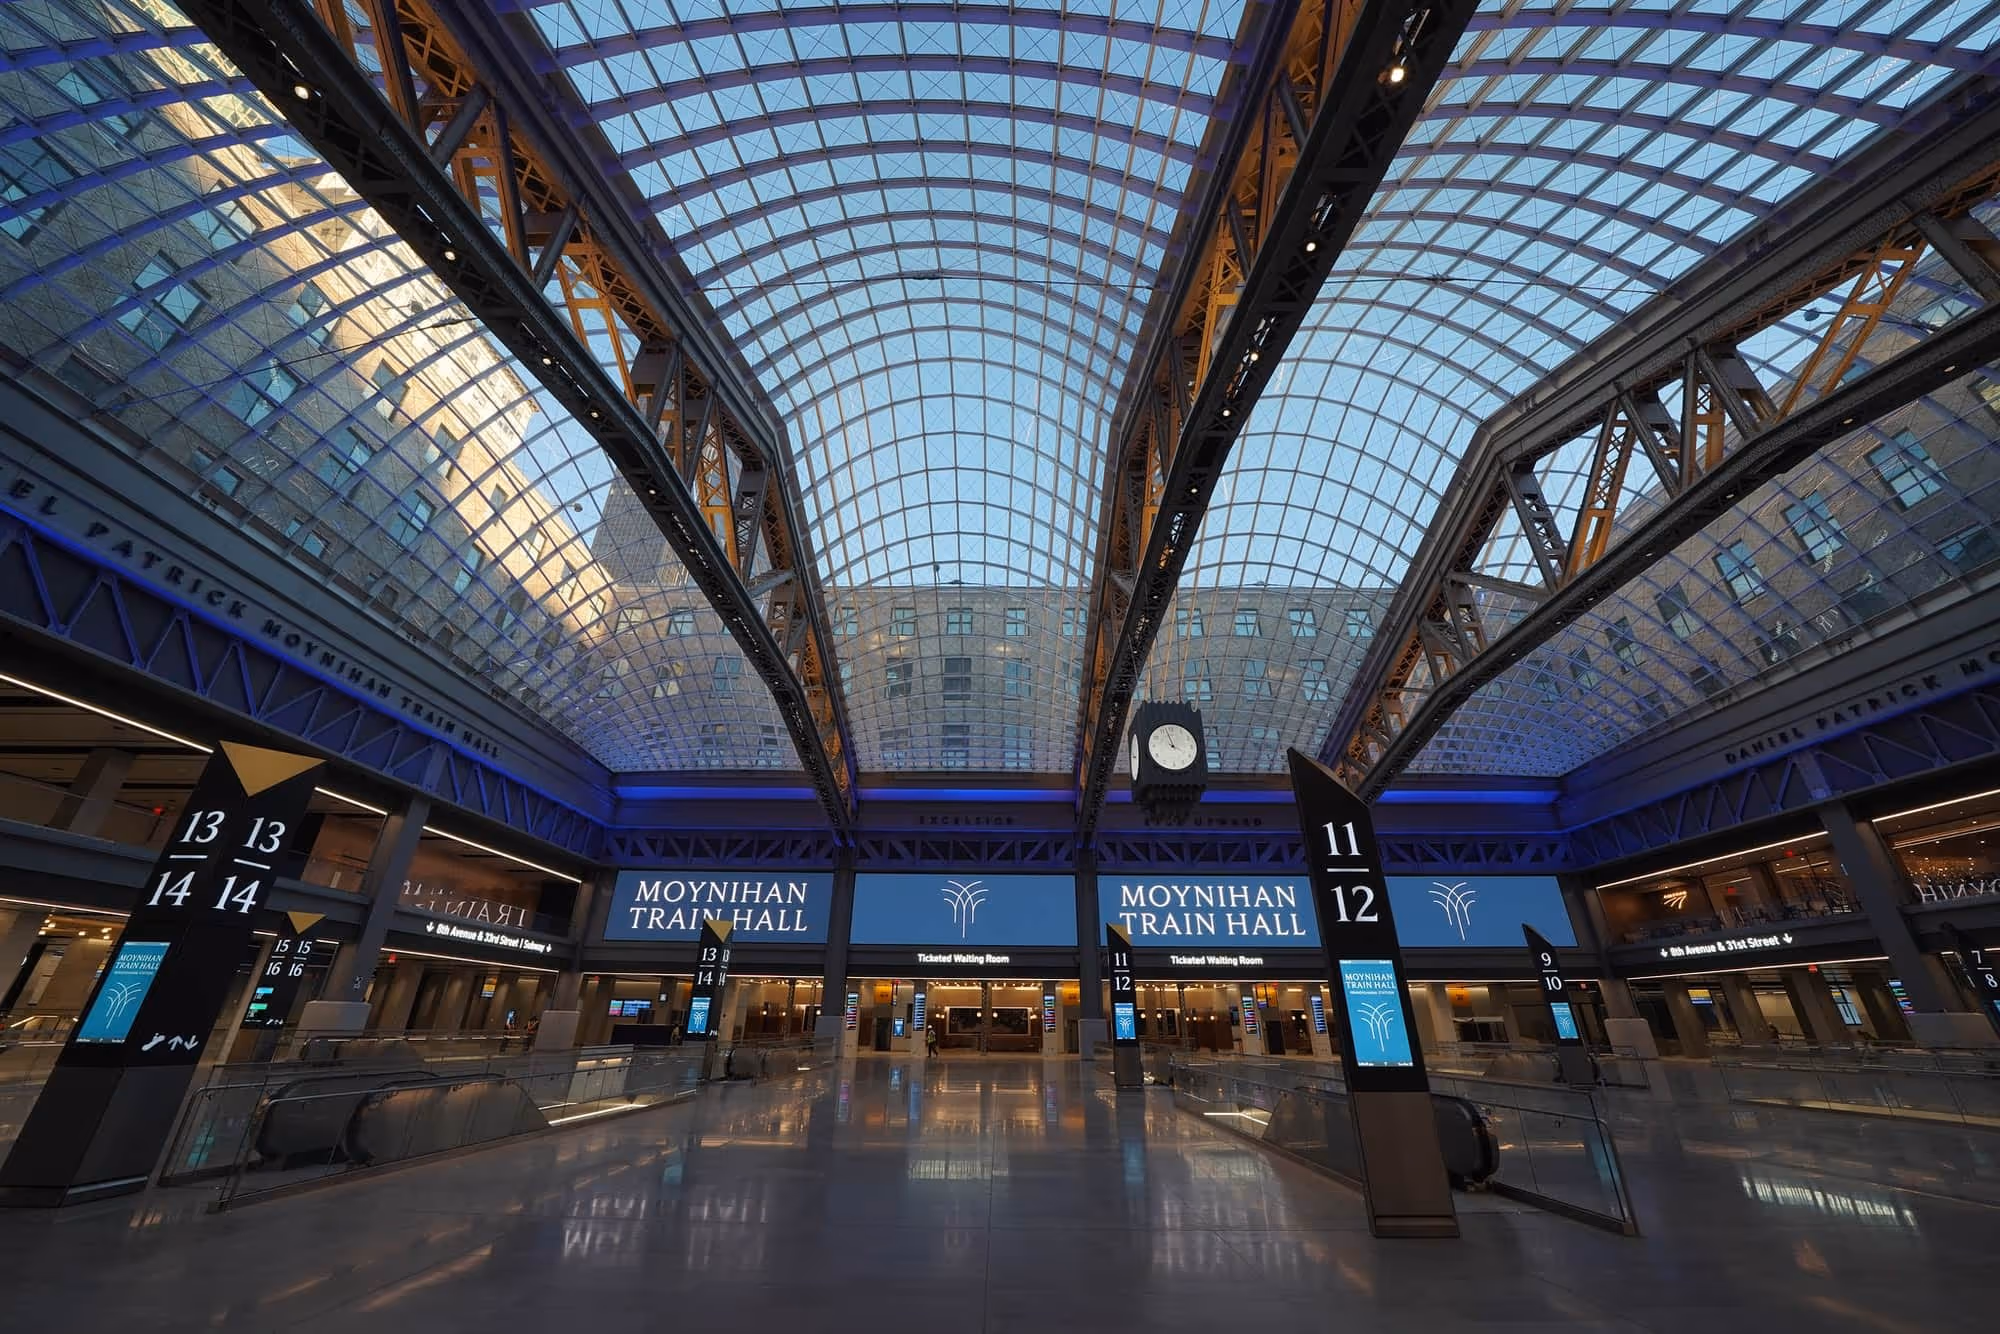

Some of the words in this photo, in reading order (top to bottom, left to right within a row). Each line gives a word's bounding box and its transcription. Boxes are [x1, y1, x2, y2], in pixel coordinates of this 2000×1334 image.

[87, 521, 247, 618] PATRICK
[262, 619, 391, 698] MOYNIHAN
[402, 696, 456, 733] TRAIN
[463, 731, 498, 758] HALL
[1726, 728, 1803, 764] DANIEL
[1816, 674, 1940, 730] PATRICK
[179, 810, 225, 843] 13
[243, 817, 286, 853] 13
[1321, 821, 1363, 856] 11
[146, 871, 195, 906] 14
[212, 875, 260, 914] 14
[635, 880, 808, 904] MOYNIHAN
[1120, 885, 1296, 908] MOYNIHAN
[1330, 885, 1379, 922] 12
[630, 907, 722, 930] TRAIN
[732, 909, 808, 931] HALL
[1119, 912, 1215, 936] TRAIN
[1225, 912, 1306, 936] HALL
[450, 925, 477, 941] Avenue
[500, 934, 520, 948] Street
[274, 939, 291, 953] 15
[297, 940, 312, 954] 15
[1669, 946, 1684, 957] 8th
[1685, 944, 1716, 955] Avenue
[1716, 941, 1726, 951] &
[1726, 939, 1747, 951] 31st
[1747, 935, 1780, 949] Street
[119, 953, 163, 961] MOYNIHAN
[701, 947, 717, 962] 13
[917, 953, 952, 964] Ticketed
[953, 953, 984, 965] Waiting
[985, 954, 1010, 964] Room
[1115, 952, 1128, 967] 11
[1170, 955, 1205, 966] Ticketed
[1206, 955, 1238, 967] Waiting
[1239, 955, 1263, 966] Room
[1540, 952, 1551, 967] 9
[1971, 950, 1982, 964] 7
[115, 961, 138, 969] TRAIN
[265, 961, 283, 976] 16
[287, 962, 304, 977] 16
[696, 970, 713, 985] 14
[1115, 976, 1131, 991] 12
[1345, 973, 1393, 981] MOYNIHAN
[1545, 976, 1562, 991] 10
[1985, 973, 1998, 988] 8
[1345, 981, 1373, 989] TRAIN
[1374, 981, 1396, 989] HALL
